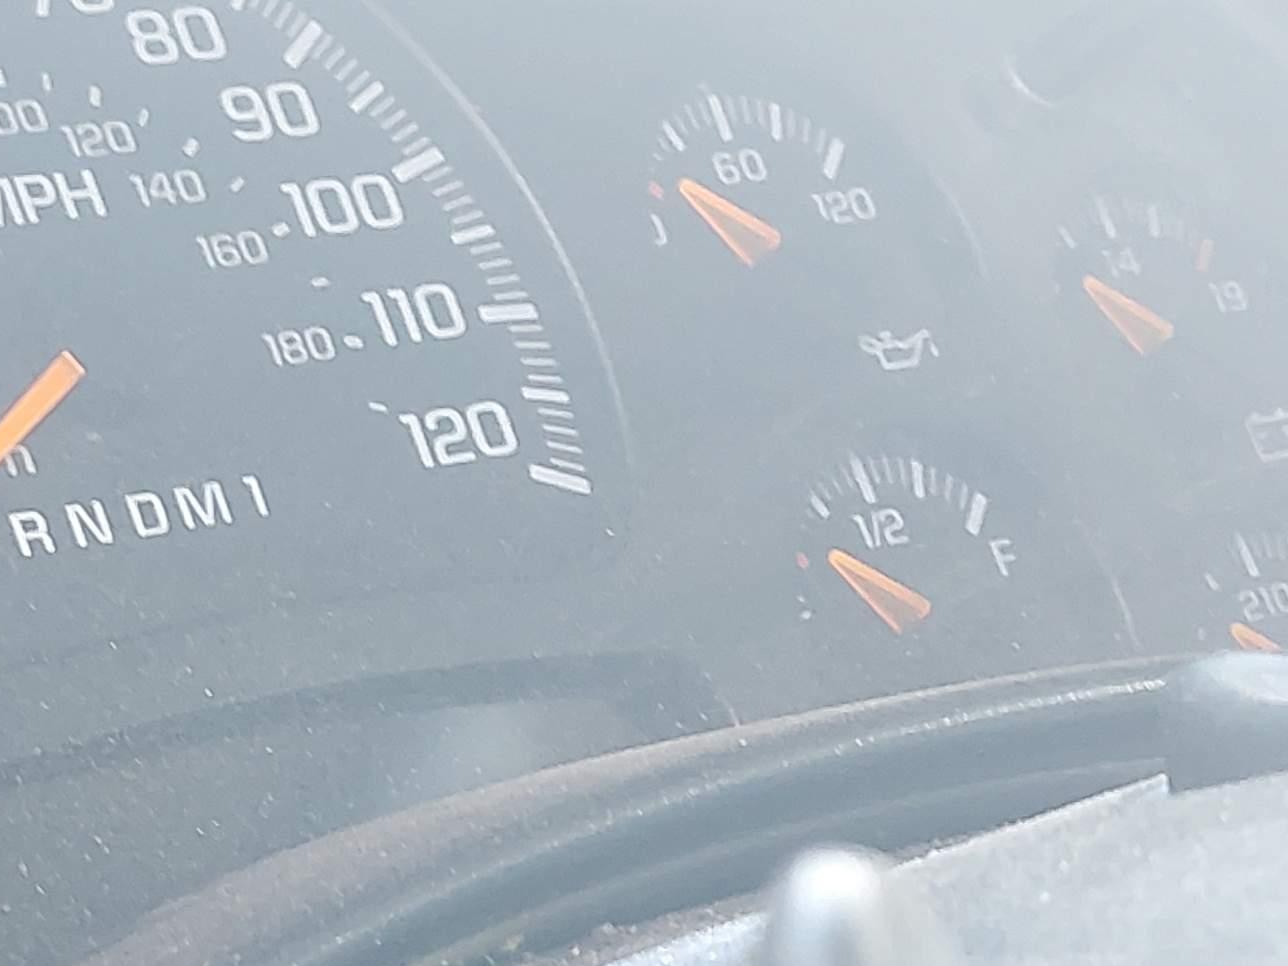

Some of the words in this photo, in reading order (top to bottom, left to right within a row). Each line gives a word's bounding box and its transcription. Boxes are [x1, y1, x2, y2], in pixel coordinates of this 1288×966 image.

[125, 5, 226, 64] 80
[220, 81, 319, 140] 90
[61, 120, 136, 157] 120
[711, 149, 766, 184] 60
[129, 169, 206, 206] 140
[280, 175, 404, 236] 100
[812, 187, 875, 223] 120
[195, 231, 267, 267] 160
[361, 282, 466, 346] 110
[262, 327, 335, 365] 180
[399, 401, 518, 467] 120
[8, 511, 56, 556] R
[65, 500, 112, 547] N
[124, 492, 169, 537] D
[173, 480, 231, 530] M
[242, 475, 270, 516] 1
[851, 507, 908, 547] 1/2
[989, 537, 1015, 575] F
